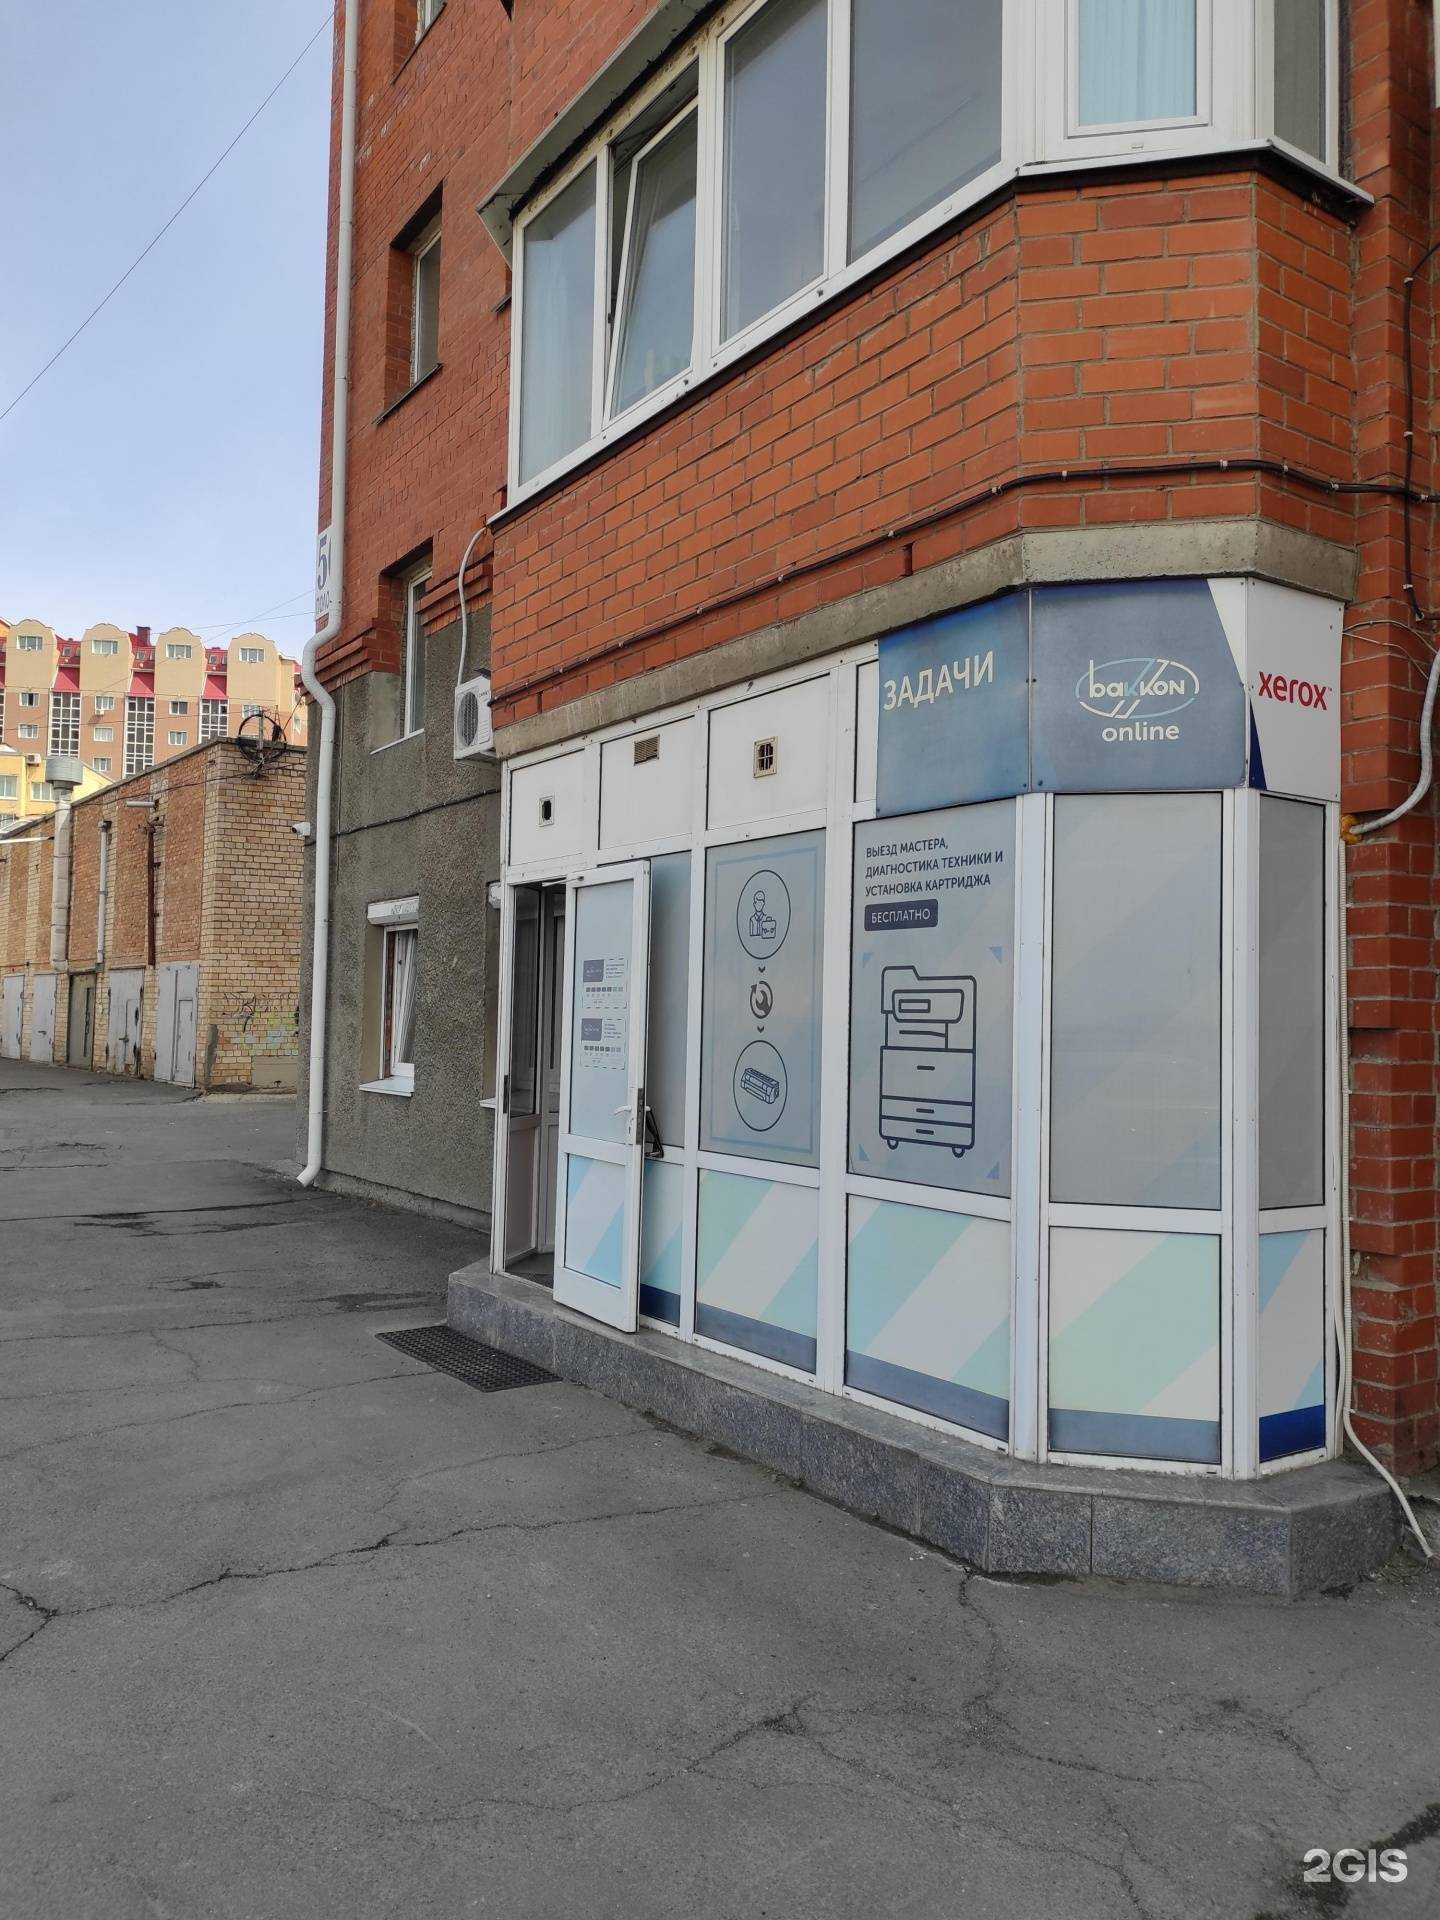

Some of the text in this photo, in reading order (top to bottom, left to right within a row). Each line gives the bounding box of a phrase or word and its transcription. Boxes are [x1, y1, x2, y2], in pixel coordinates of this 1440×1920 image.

[883, 650, 994, 711] ЗАДАЧИ
[1258, 671, 1327, 711] xerox
[1101, 721, 1180, 742] online
[866, 837, 949, 858] ВЫЕЗД МАСТЕРА,
[865, 850, 1004, 879] ДИАГНОСТИКА ТЕХНИКИ И
[865, 873, 992, 898] УСТАНОВКА КАРТРИДЖА
[871, 908, 931, 924] БЕСПЛАТНО
